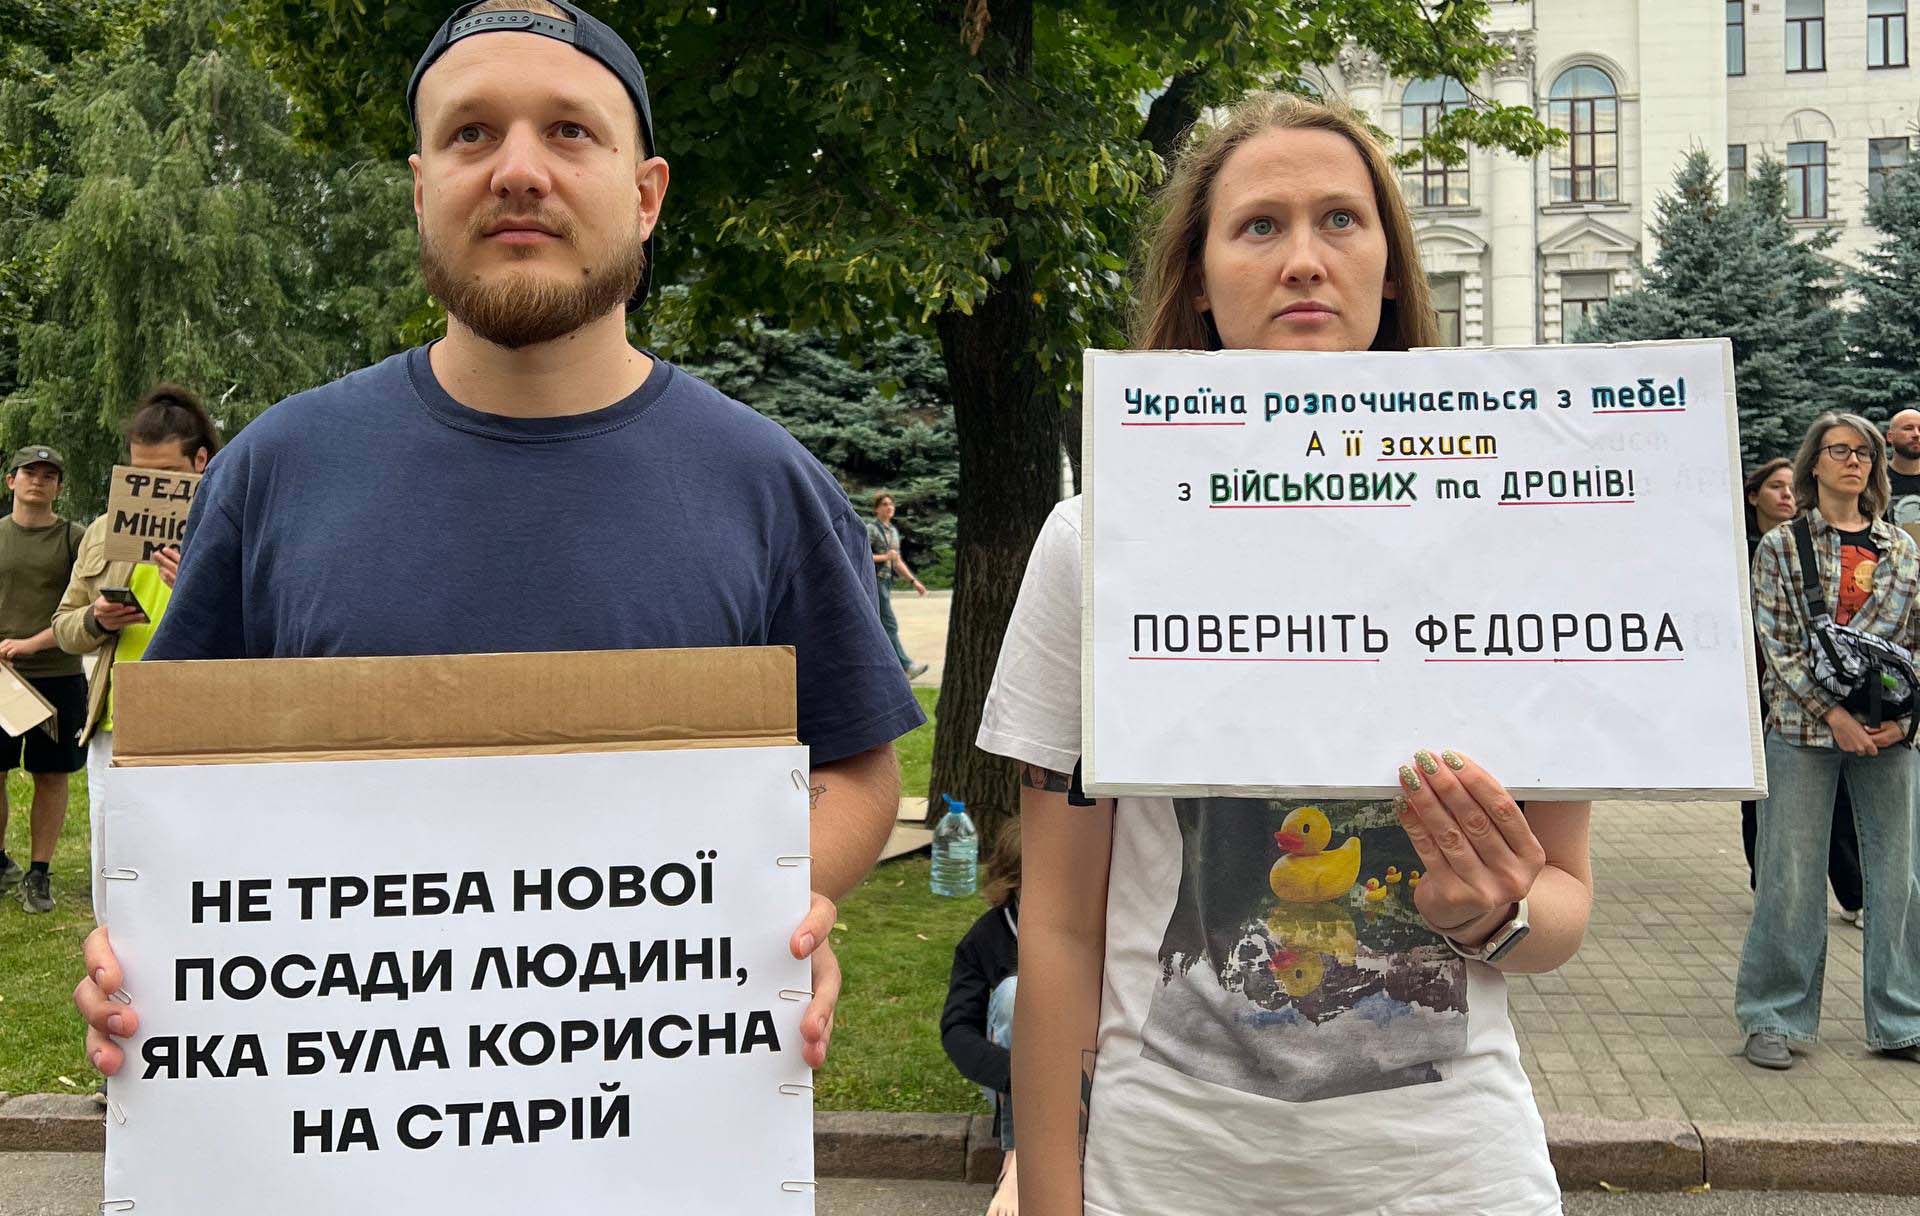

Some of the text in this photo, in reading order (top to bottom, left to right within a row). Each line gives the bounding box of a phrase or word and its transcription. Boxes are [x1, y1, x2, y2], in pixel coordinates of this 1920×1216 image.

[1124, 375, 1687, 423] Україна розпочинається з тебе!
[1305, 429, 1498, 458] А її захист
[125, 474, 200, 504] ФЕД
[1178, 481, 1192, 503] з
[1436, 478, 1482, 500] та
[1499, 464, 1636, 502] ДРОНІВ!
[1133, 612, 1685, 657] ПОВЕРНІТЬ ФЕДОРОВА
[190, 848, 719, 925] НЕ ТРЕБА НОВОЇ
[174, 935, 749, 1003] ПОСАДИ ЛЮДИНІ,
[140, 1009, 783, 1081] ЯКА БУЛА КОРИСНА
[292, 1080, 631, 1155] НА СТАРІЙ
